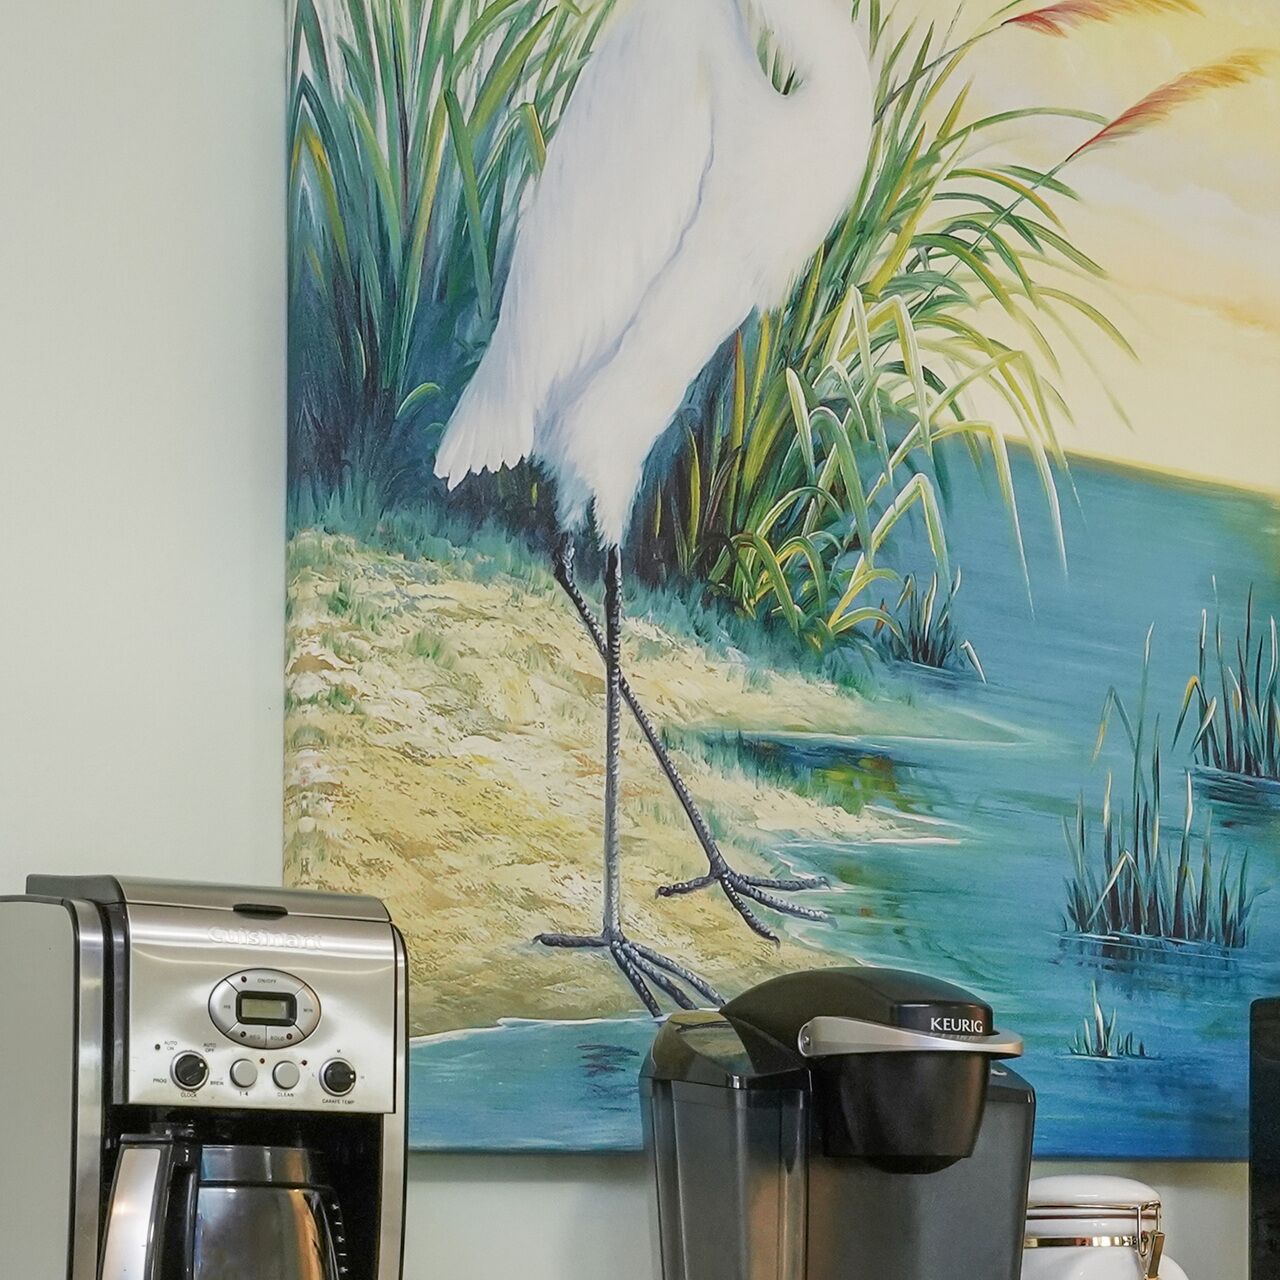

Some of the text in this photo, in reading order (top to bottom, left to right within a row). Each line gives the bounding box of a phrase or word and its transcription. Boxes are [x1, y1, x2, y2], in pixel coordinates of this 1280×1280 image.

[207, 926, 322, 950] Cuisinart
[930, 1017, 984, 1033] KEURIG
[180, 1091, 198, 1099] CLOCK
